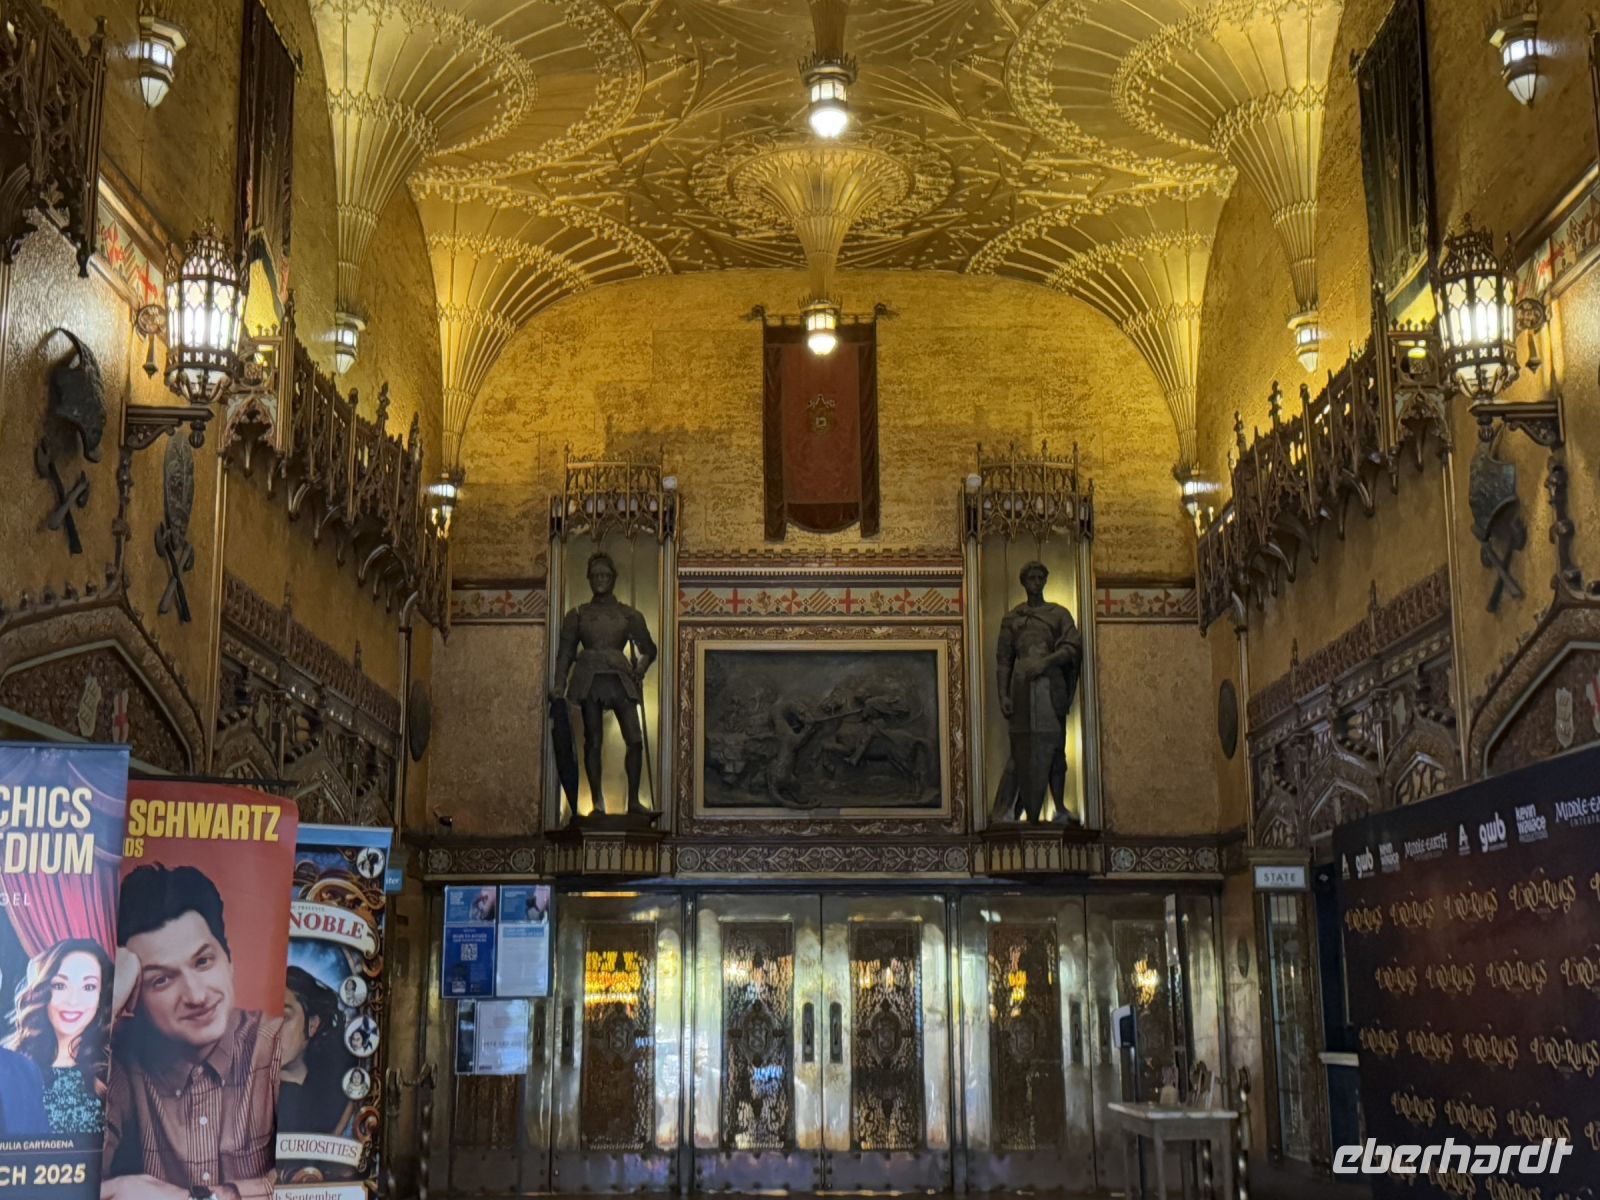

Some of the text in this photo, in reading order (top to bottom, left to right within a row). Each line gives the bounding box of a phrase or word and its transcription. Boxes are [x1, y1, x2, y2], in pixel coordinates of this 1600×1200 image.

[128, 798, 281, 842] SCHWARTZ
[1479, 811, 1506, 853] gwb
[0, 831, 95, 875] DIUM
[1263, 872, 1296, 882] STATE
[289, 911, 365, 940] NOBLE
[280, 1139, 358, 1158] CURIOSITIES
[33, 1162, 87, 1186] 2025
